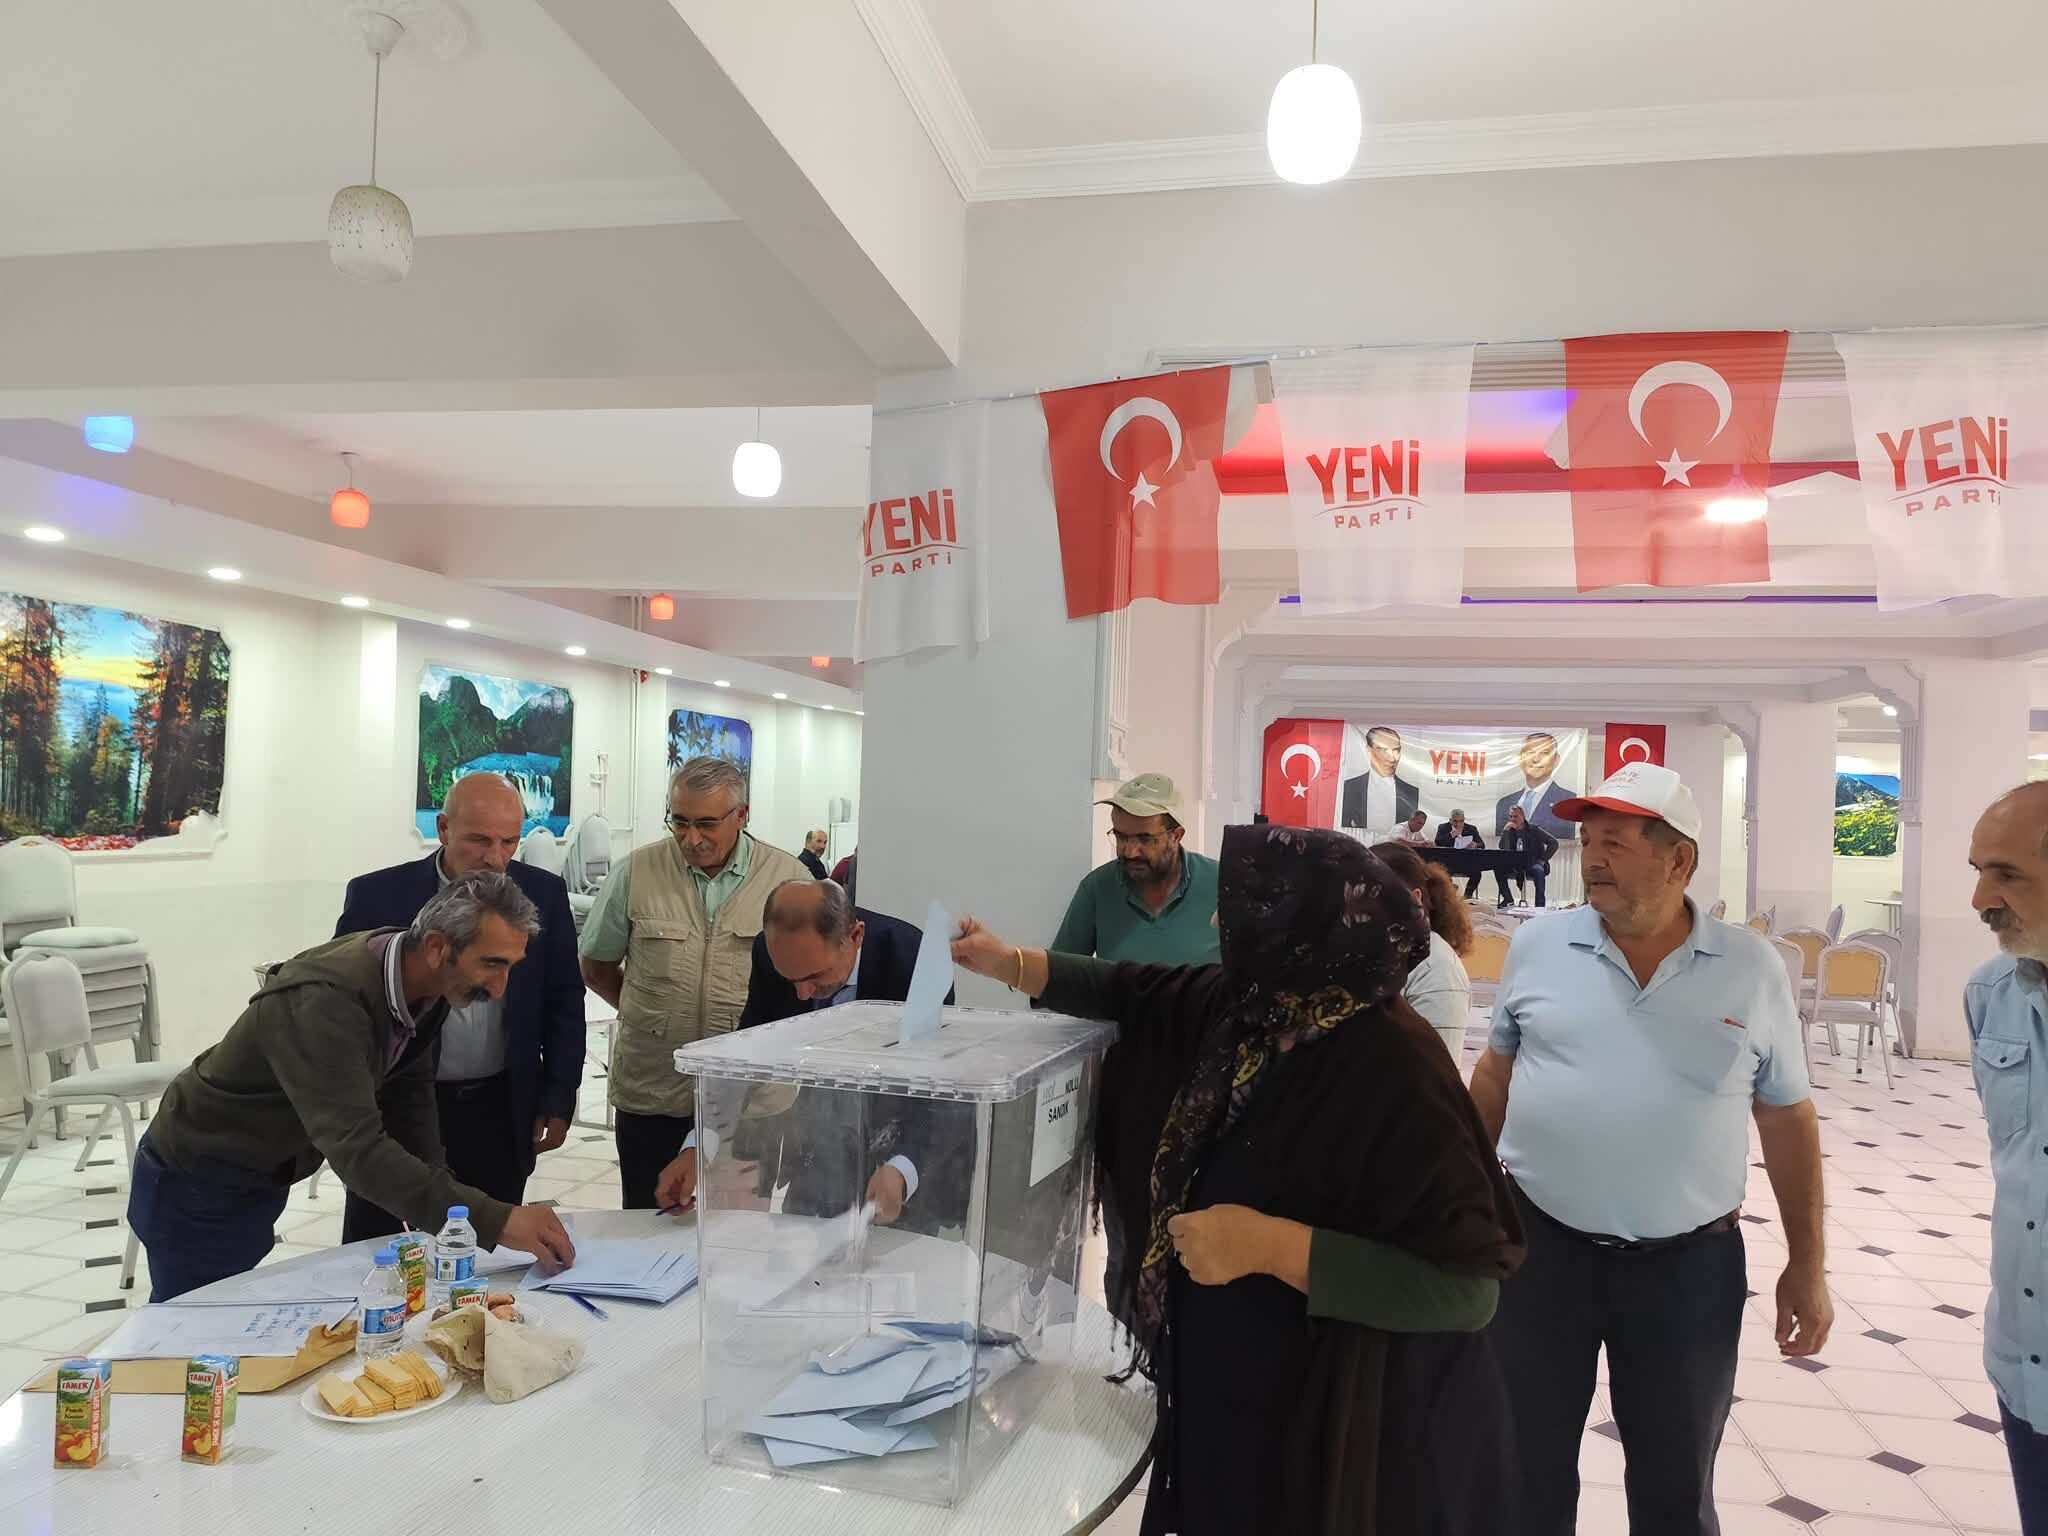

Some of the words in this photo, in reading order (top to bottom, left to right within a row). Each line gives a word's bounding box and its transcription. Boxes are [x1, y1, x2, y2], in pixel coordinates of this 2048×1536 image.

[458, 1295, 480, 1304] TAMEK
[190, 1374, 212, 1382] TAMEK
[62, 1382, 88, 1390] TAMEK
